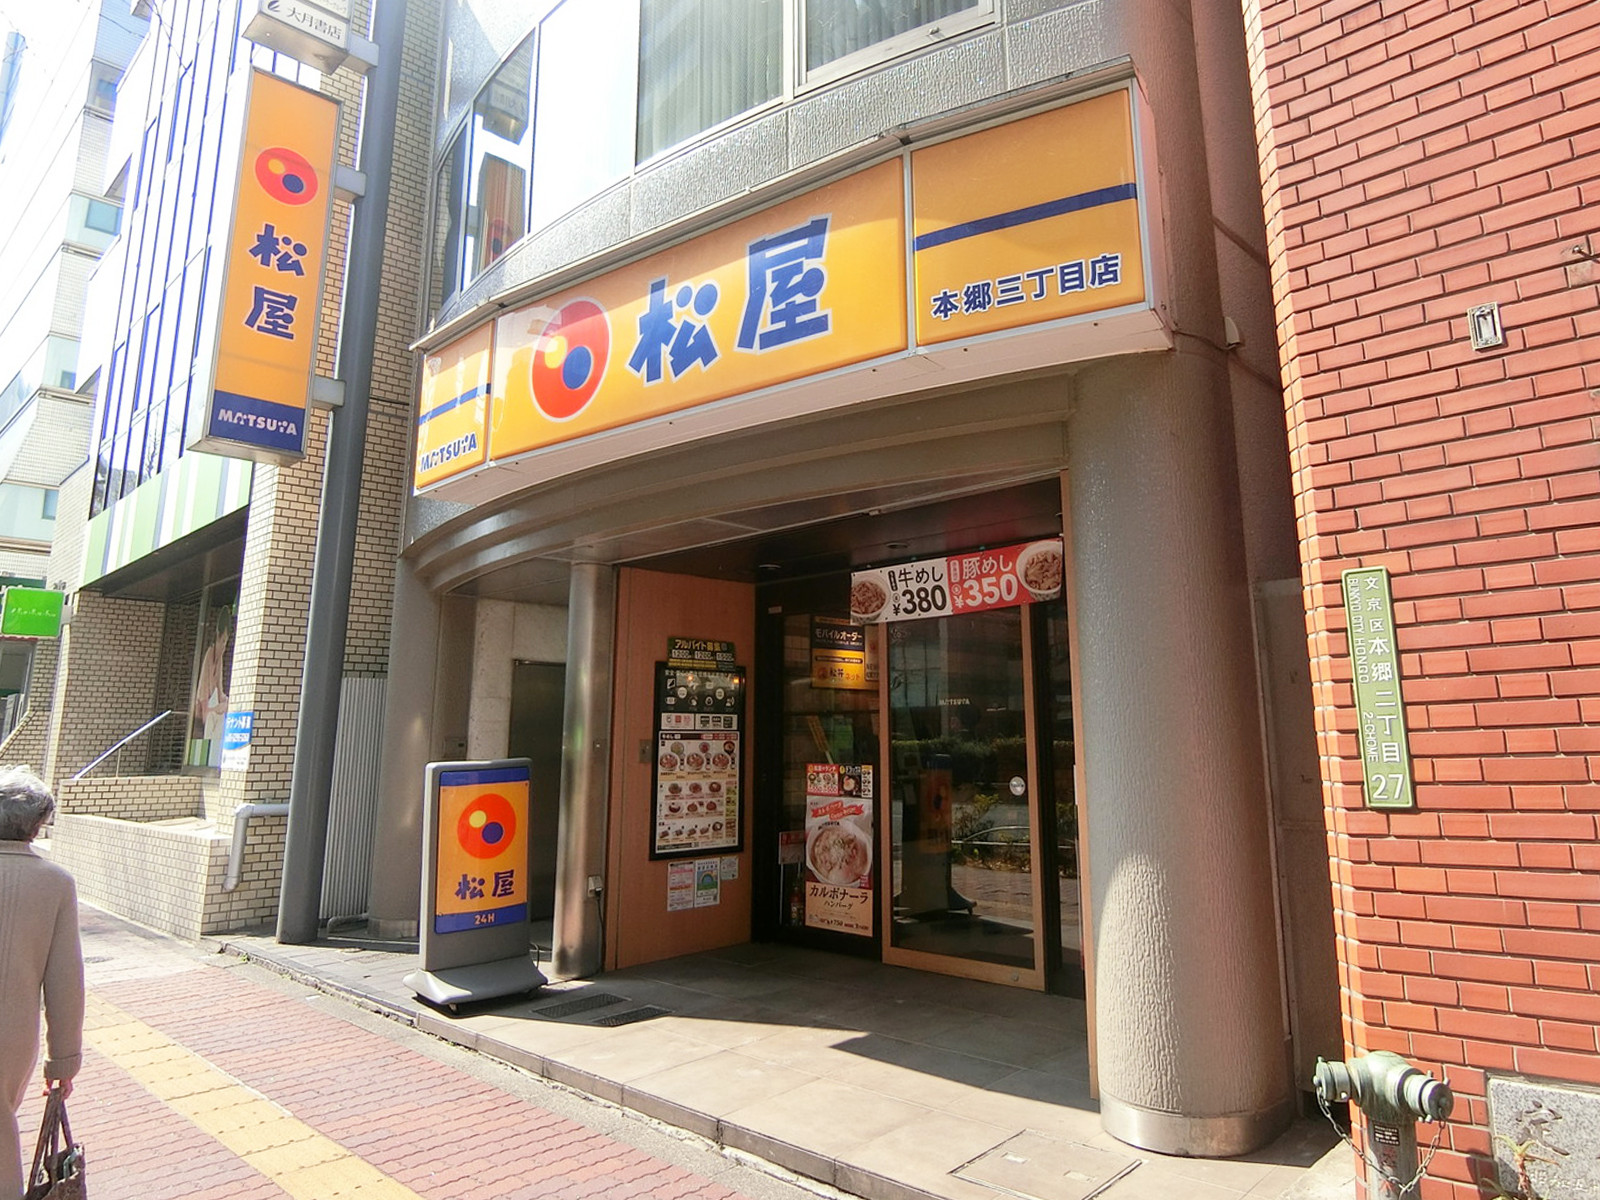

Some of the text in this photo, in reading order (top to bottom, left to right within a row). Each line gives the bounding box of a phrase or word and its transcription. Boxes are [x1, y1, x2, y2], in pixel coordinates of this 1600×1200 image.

[287, 7, 341, 40] 大月書店
[245, 223, 308, 340] 松屋
[931, 253, 1121, 320] 本郷三丁目店
[627, 215, 832, 386] 松屋
[217, 408, 298, 436] MATSUYA
[420, 432, 477, 473] MATSUYA
[898, 566, 943, 588] 牛めし
[962, 554, 1013, 579] 豚めし
[892, 584, 947, 616] ¥380
[953, 574, 1018, 609] ¥350
[815, 629, 863, 641] モバイルオーダー
[1352, 615, 1365, 634] CITY
[1355, 638, 1370, 684] HONGO
[1363, 711, 1380, 763] 2-CHOME
[1370, 773, 1405, 800] 27
[455, 869, 515, 900] 松屋
[810, 885, 869, 904] カルボナーラ
[474, 912, 495, 925] 24H
